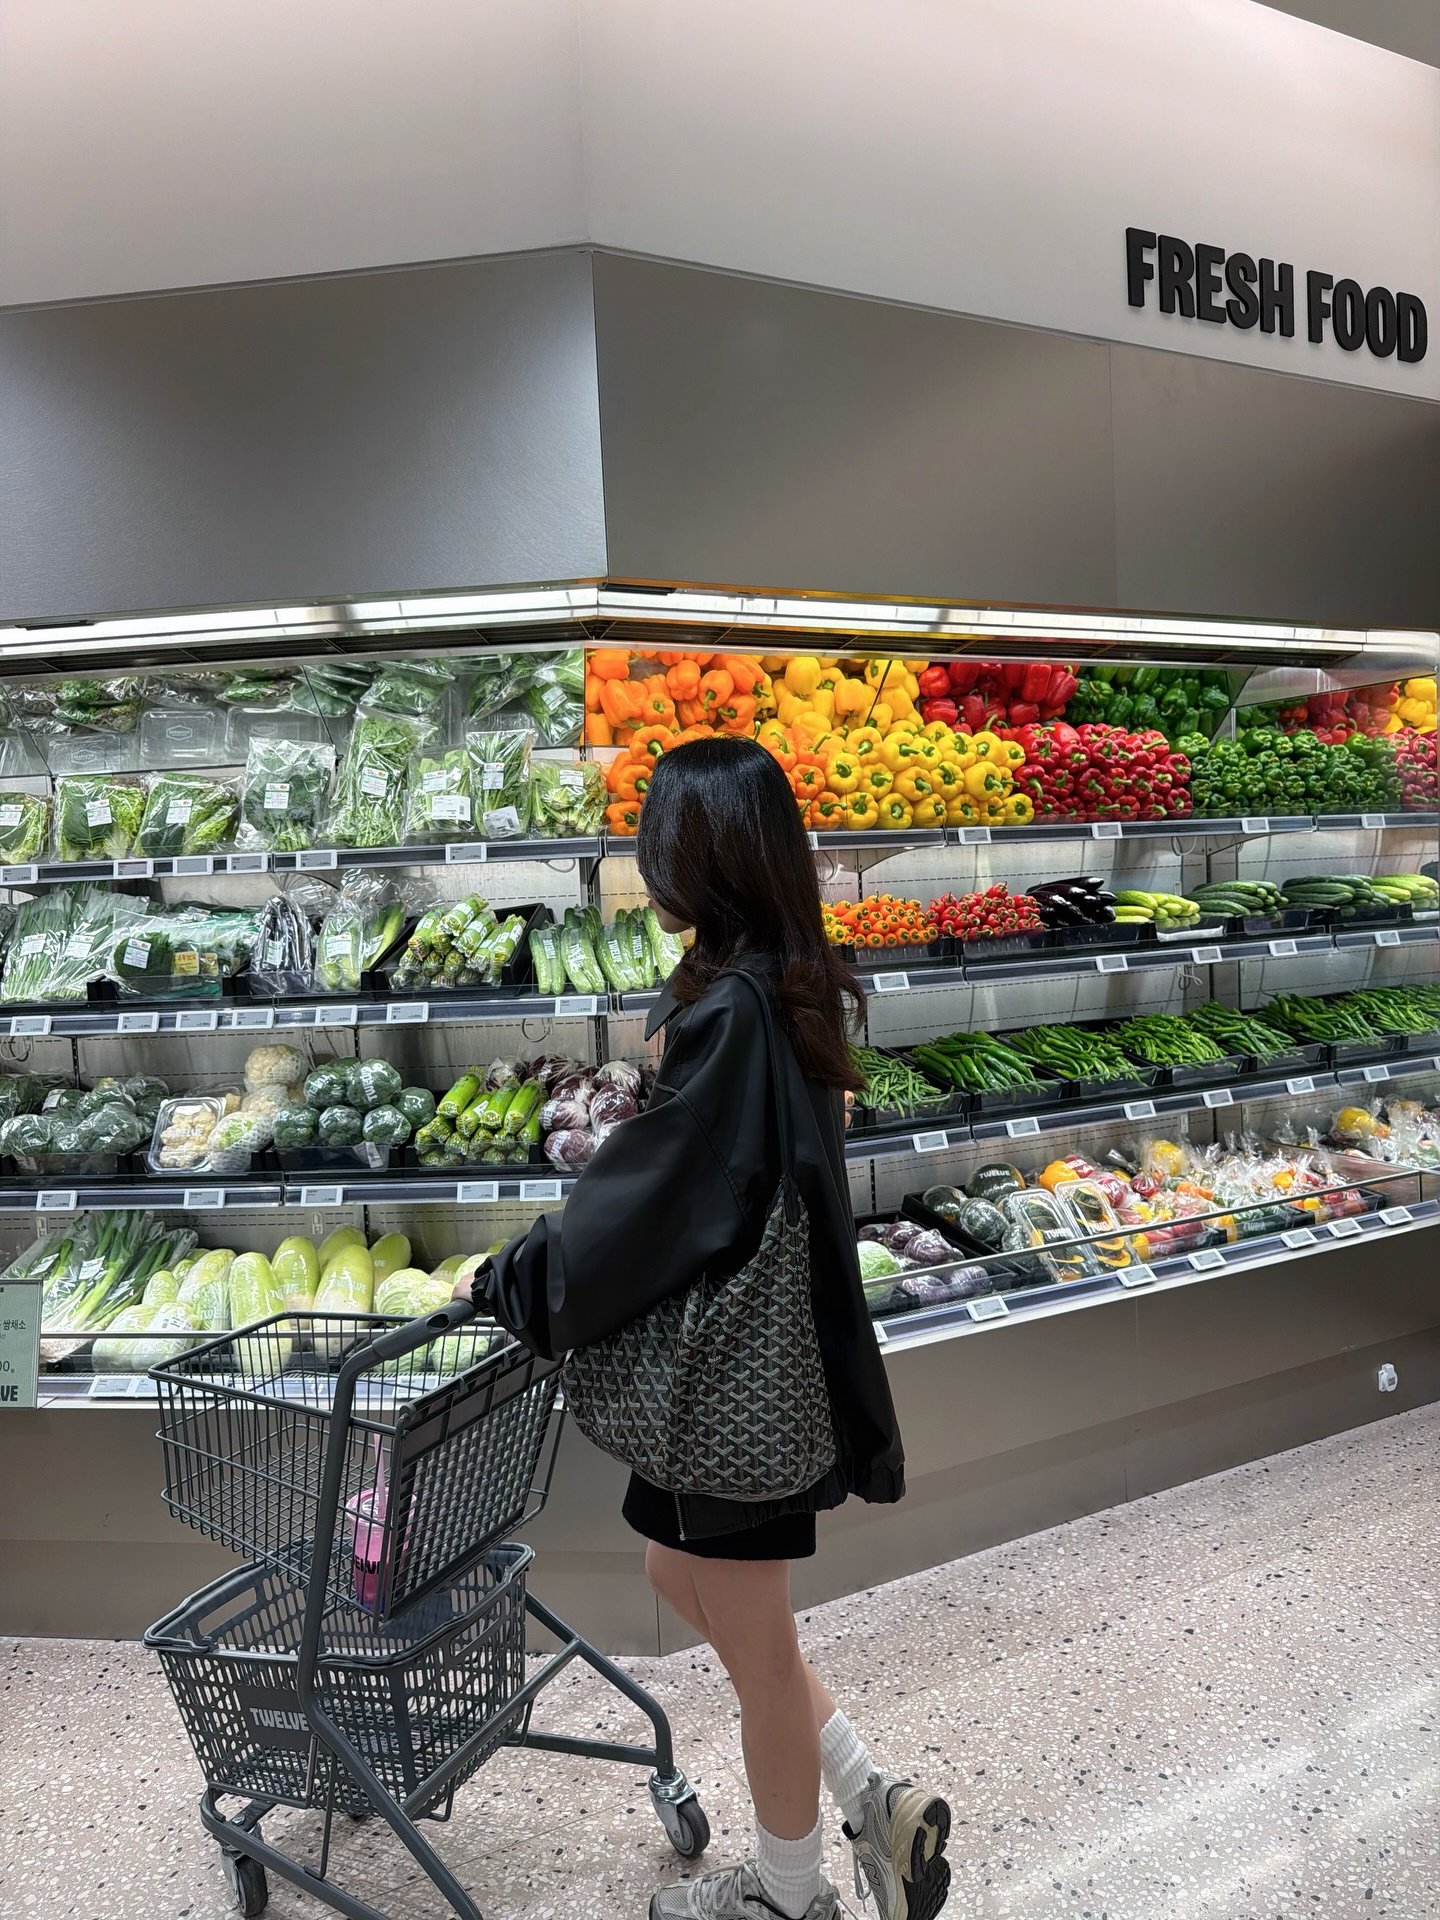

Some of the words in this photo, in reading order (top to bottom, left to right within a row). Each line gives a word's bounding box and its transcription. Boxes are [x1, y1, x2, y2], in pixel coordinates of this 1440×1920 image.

[1126, 227, 1294, 337] FRESH
[1307, 270, 1428, 363] FOOD
[979, 1169, 1011, 1180] TWELVE
[249, 1707, 309, 1731] TWELVE
